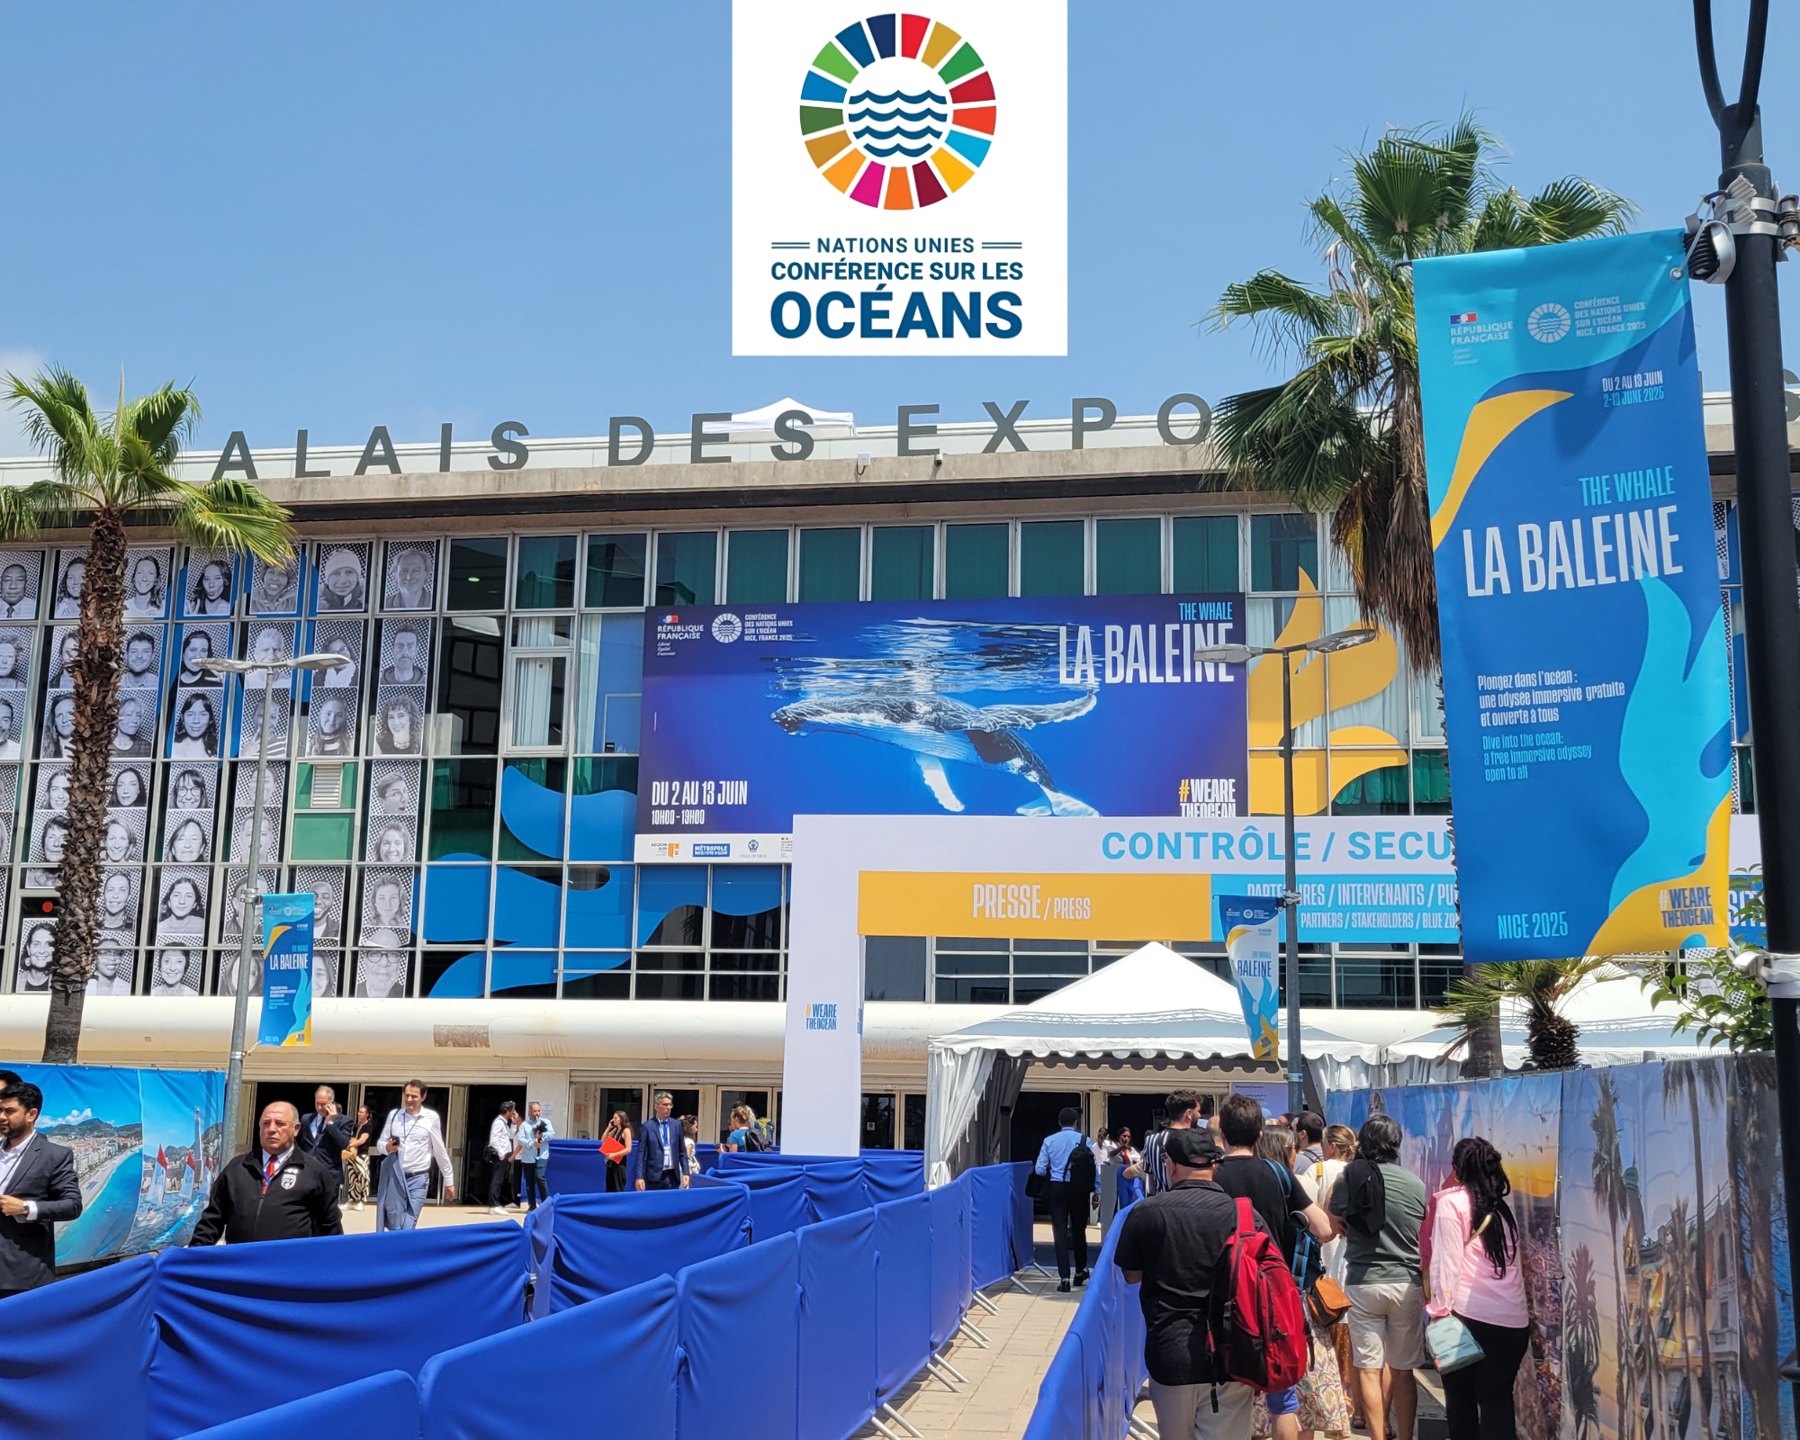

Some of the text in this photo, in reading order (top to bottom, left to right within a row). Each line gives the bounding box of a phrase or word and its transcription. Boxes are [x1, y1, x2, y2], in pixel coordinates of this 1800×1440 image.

[1591, 304, 1621, 317] NATIONS
[1450, 321, 1514, 336] RÉPUBLIQUE
[1575, 318, 1591, 329] SUR
[1596, 323, 1626, 335] FRANCE
[1627, 321, 1646, 332] 2025
[1451, 331, 1510, 346] FRANÇAISE
[1602, 370, 1663, 392] DU 2 AU 13 JUIN
[1603, 386, 1664, 407] 2-13 JUNE 2025
[212, 393, 1212, 480] ALAIS DES EXPO
[1579, 465, 1676, 507] THE WHALE
[1463, 505, 1683, 597] LA BALEINE
[1179, 602, 1233, 621] THE WHALE
[657, 624, 704, 633] RÉPUBLIQUE
[657, 632, 701, 640] FRANÇAISE
[1059, 623, 1234, 685] LA BALEINE
[1478, 674, 1513, 691] Plongez
[1515, 671, 1537, 688] dans
[1538, 670, 1573, 686] l'océan
[1479, 681, 1626, 709] une odysée immersive gratuite
[1480, 707, 1559, 727] et ouverte à tous
[1482, 732, 1564, 750] Dive into the ocean:
[1484, 744, 1592, 765] a free immersive odyssey
[1485, 765, 1528, 782] open to all
[651, 781, 747, 806] DU 2 AU 13 JUIN
[1179, 779, 1236, 803] #WEARE
[651, 809, 675, 825] 10H00
[681, 809, 705, 825] 19H00
[1180, 803, 1236, 817] THEOCEAN
[1102, 825, 1311, 860] CONTRÔLE
[1321, 832, 1335, 863] /
[972, 884, 1041, 919] PRESSE
[1053, 897, 1091, 919] PRESS
[1338, 883, 1425, 906] INTERVENANTS
[1659, 886, 1712, 911] #WEARE
[1300, 912, 1342, 928] PARTNERS
[1351, 912, 1414, 928] STAKEHOLDERS
[1422, 912, 1443, 928] BLUE
[1497, 911, 1568, 939] NICE 2025
[1661, 908, 1714, 928] THEOCEAN
[270, 953, 308, 970] LA BALEINE
[806, 1003, 837, 1017] #WEARE
[806, 1018, 836, 1030] THEOCEAN
